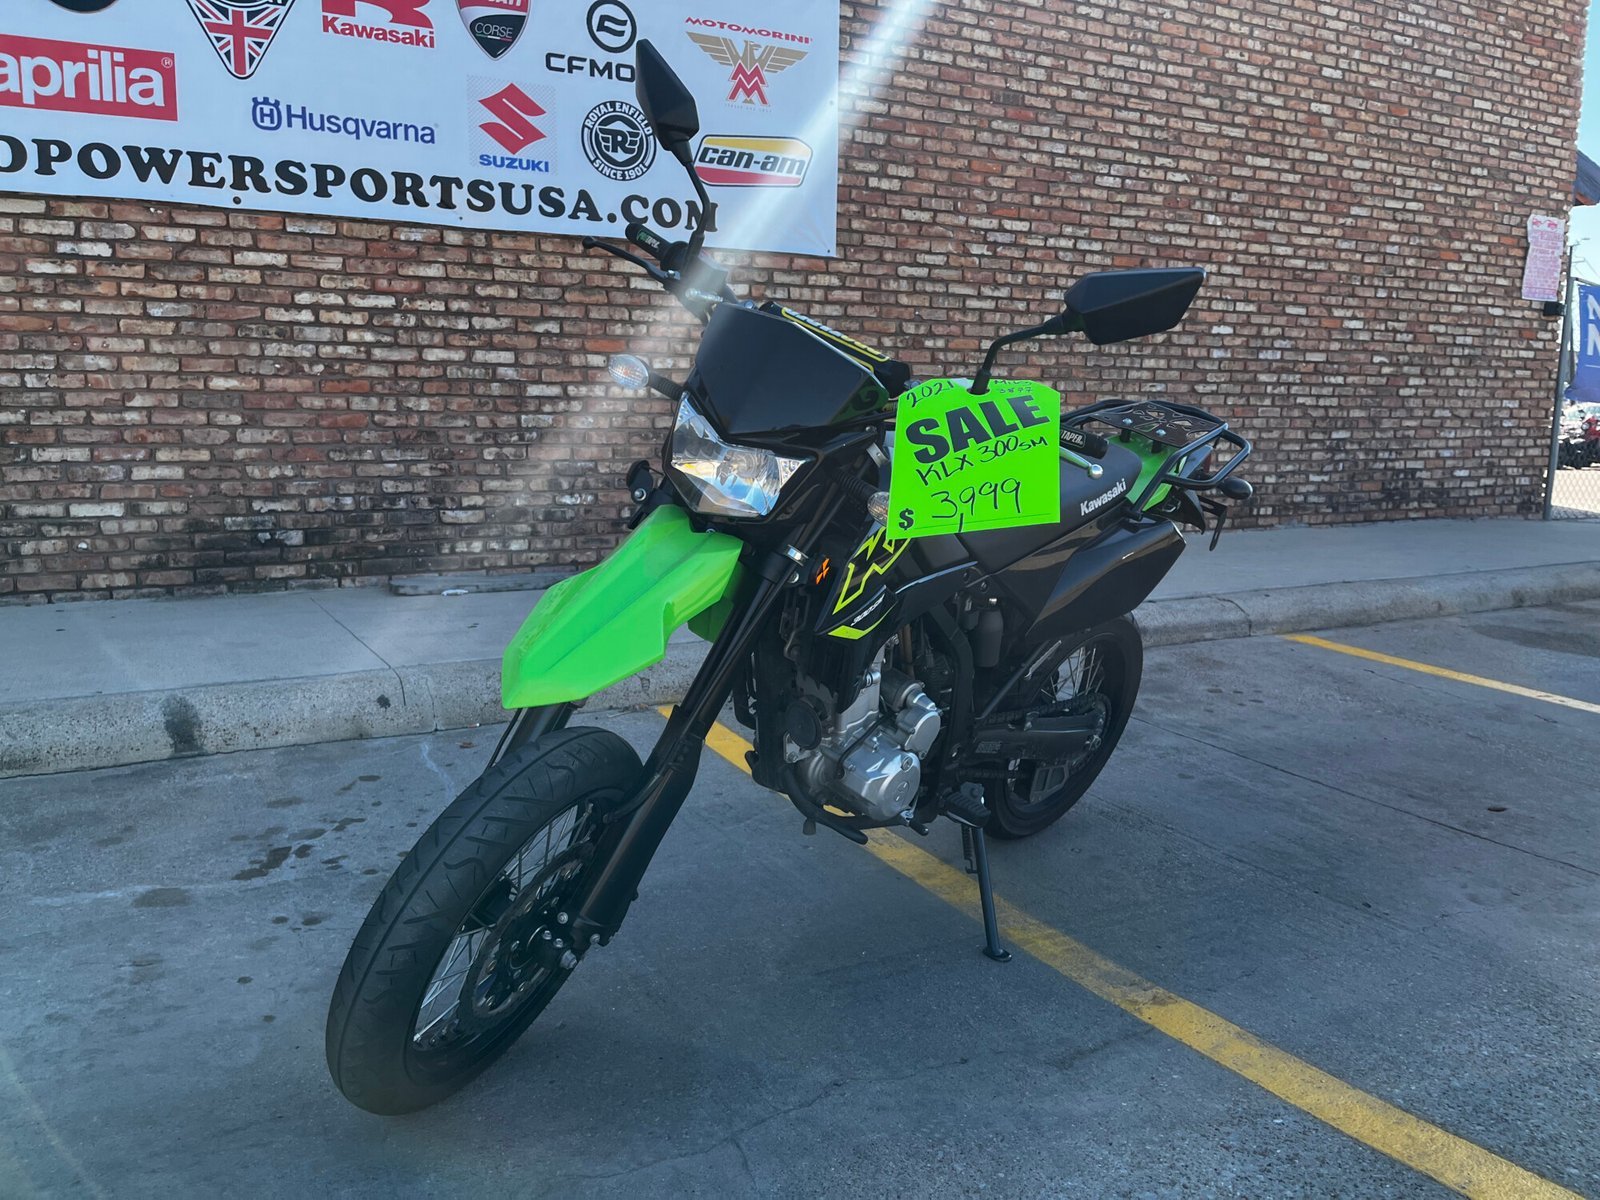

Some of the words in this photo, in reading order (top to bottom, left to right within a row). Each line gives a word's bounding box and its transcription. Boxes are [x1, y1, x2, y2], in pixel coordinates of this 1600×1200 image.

[321, 14, 435, 49] Kawasaki
[474, 22, 514, 39] CORSE
[0, 49, 166, 107] aprilia
[545, 52, 636, 83] CFMO
[286, 104, 436, 145] Husqvarna
[584, 102, 614, 129] ROYAL
[615, 101, 654, 136] ENFIELD
[478, 153, 550, 174] SUZUKI
[592, 159, 624, 180] SINCE
[624, 163, 649, 180] 1901
[698, 146, 807, 177] can-am
[906, 380, 955, 408] 2021
[905, 394, 1051, 464] SALE
[916, 454, 975, 486] KLX
[1080, 478, 1127, 516] Kawasaki
[898, 508, 915, 530] $
